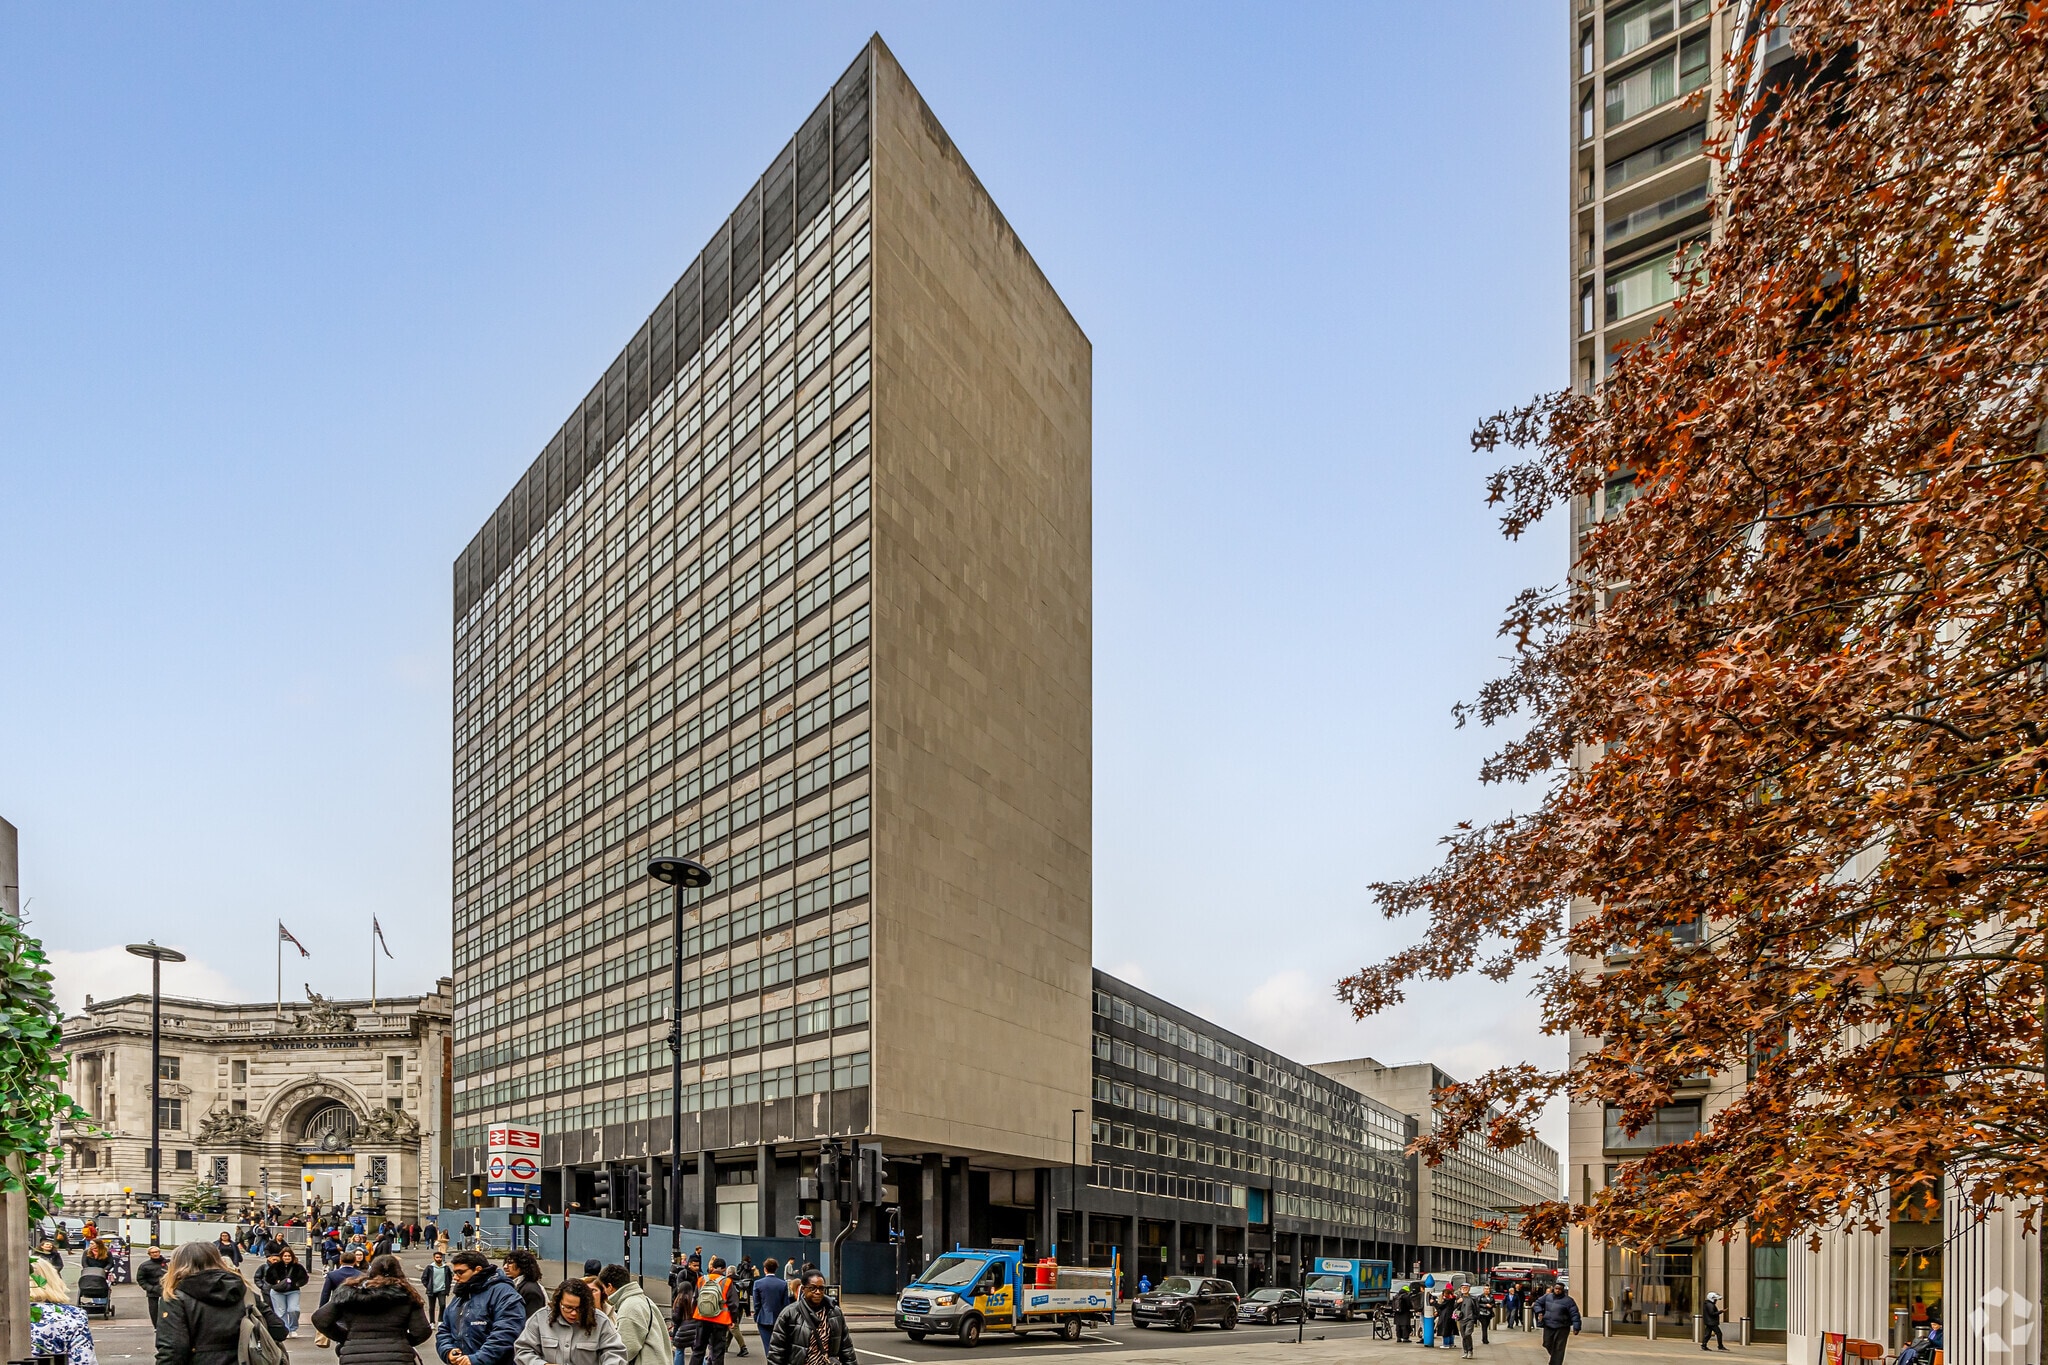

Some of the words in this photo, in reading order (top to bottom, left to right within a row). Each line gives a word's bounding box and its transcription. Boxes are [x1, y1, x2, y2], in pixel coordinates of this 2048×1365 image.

[272, 1042, 319, 1050] WATERLOO
[322, 1041, 359, 1049] STATION
[986, 1293, 1006, 1307] HSS
